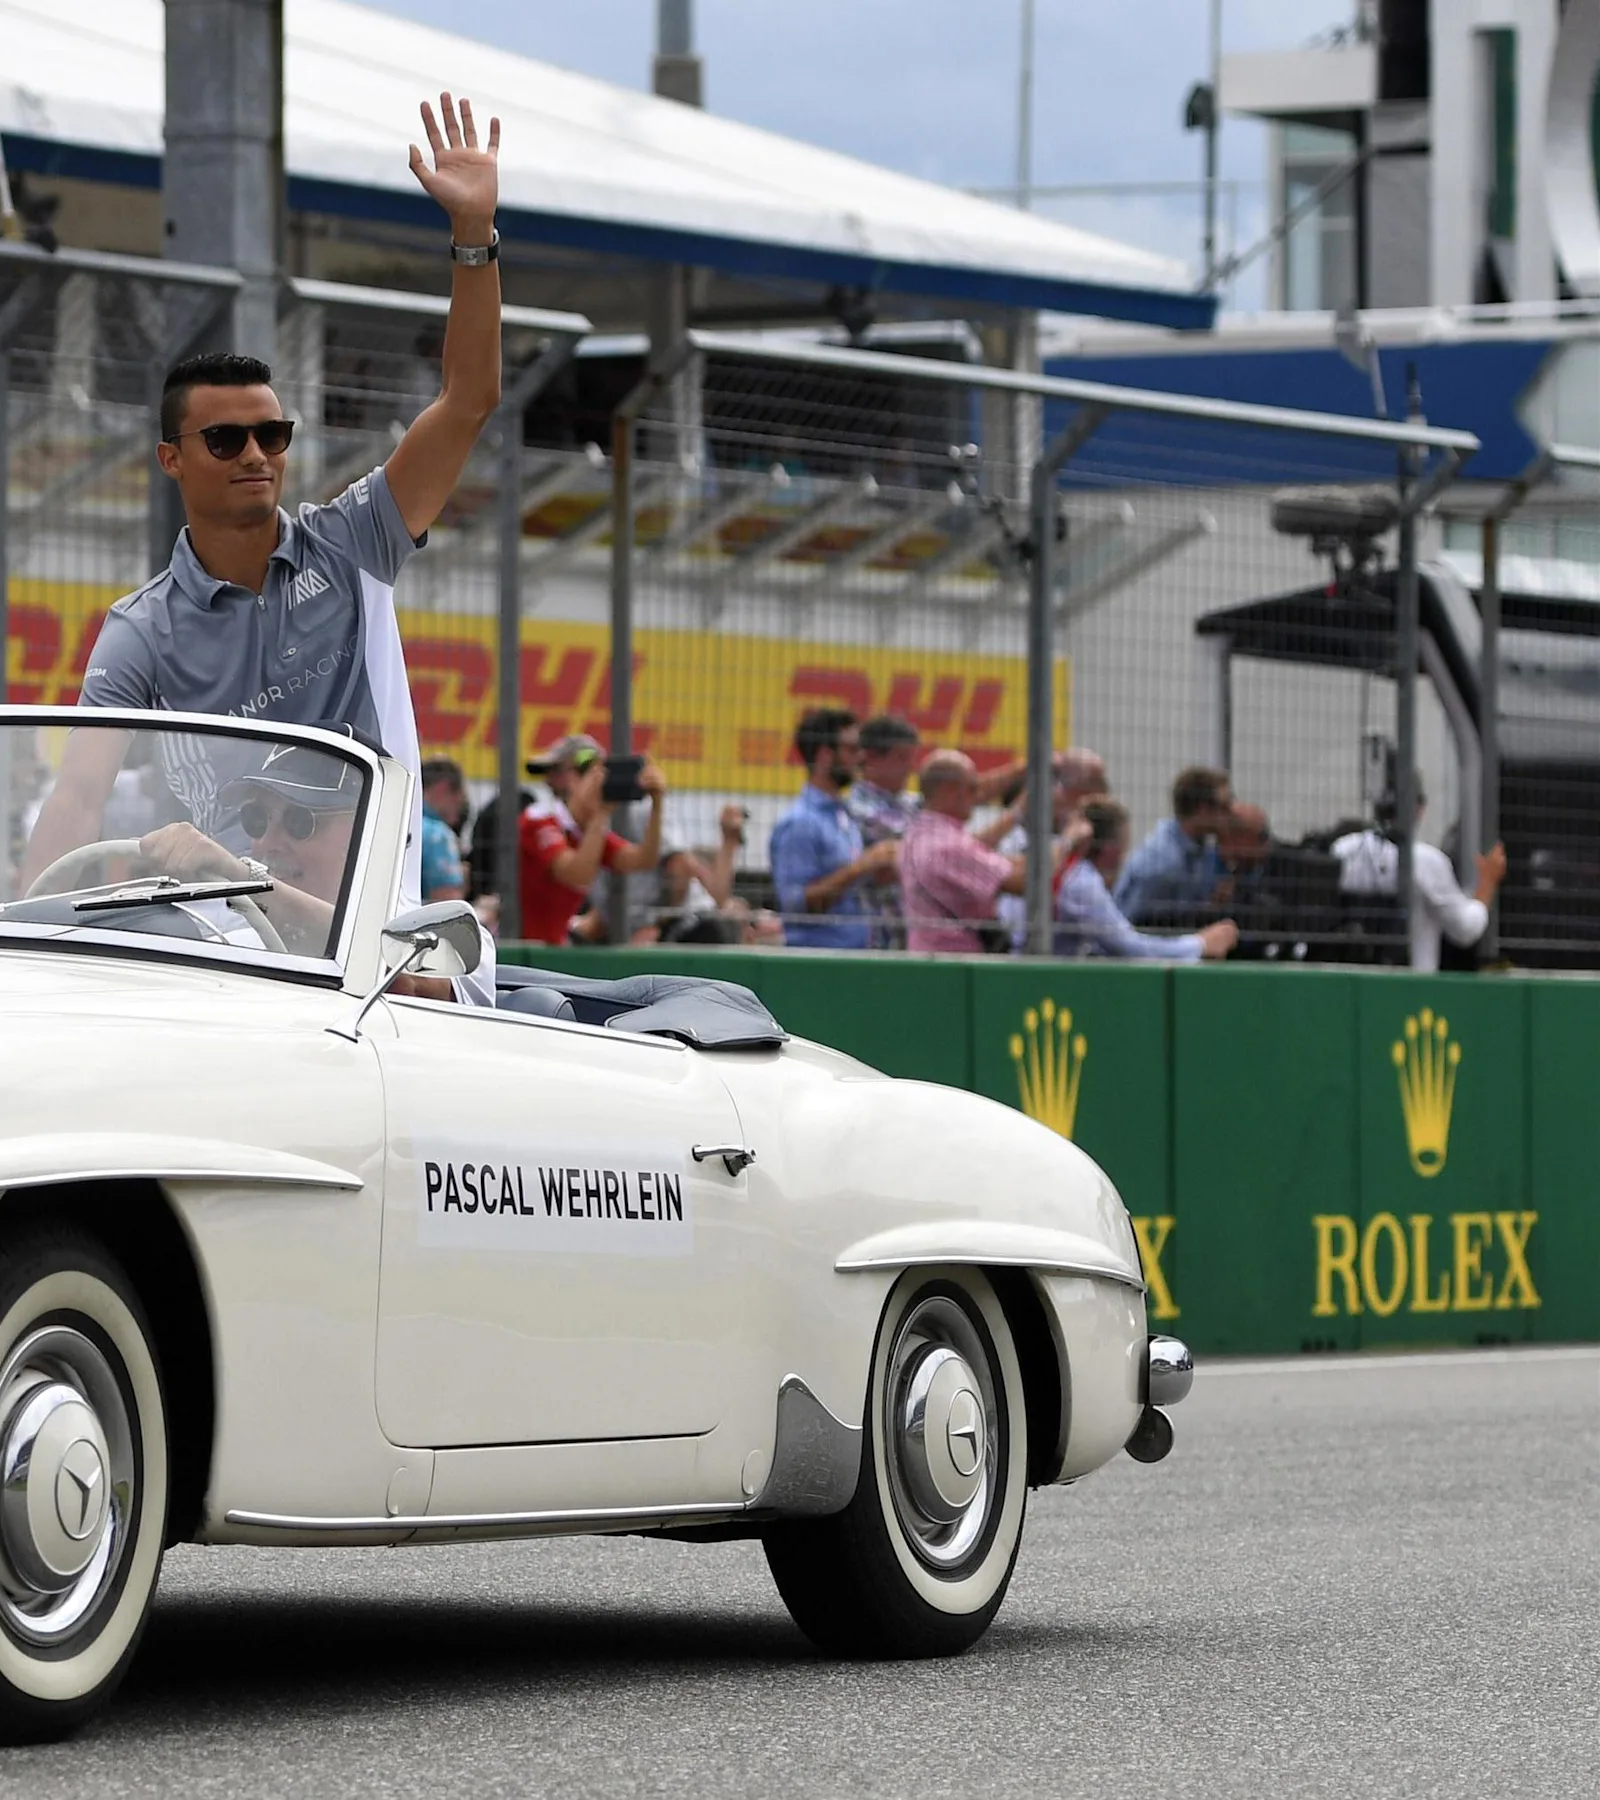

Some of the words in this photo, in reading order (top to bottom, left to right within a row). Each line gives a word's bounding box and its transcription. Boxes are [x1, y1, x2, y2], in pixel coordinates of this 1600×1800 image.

[227, 685, 286, 717] ANOR
[424, 1161, 535, 1216] PASCAL
[537, 1165, 684, 1222] WEHRLEIN
[1312, 1210, 1541, 1318] ROLEX
